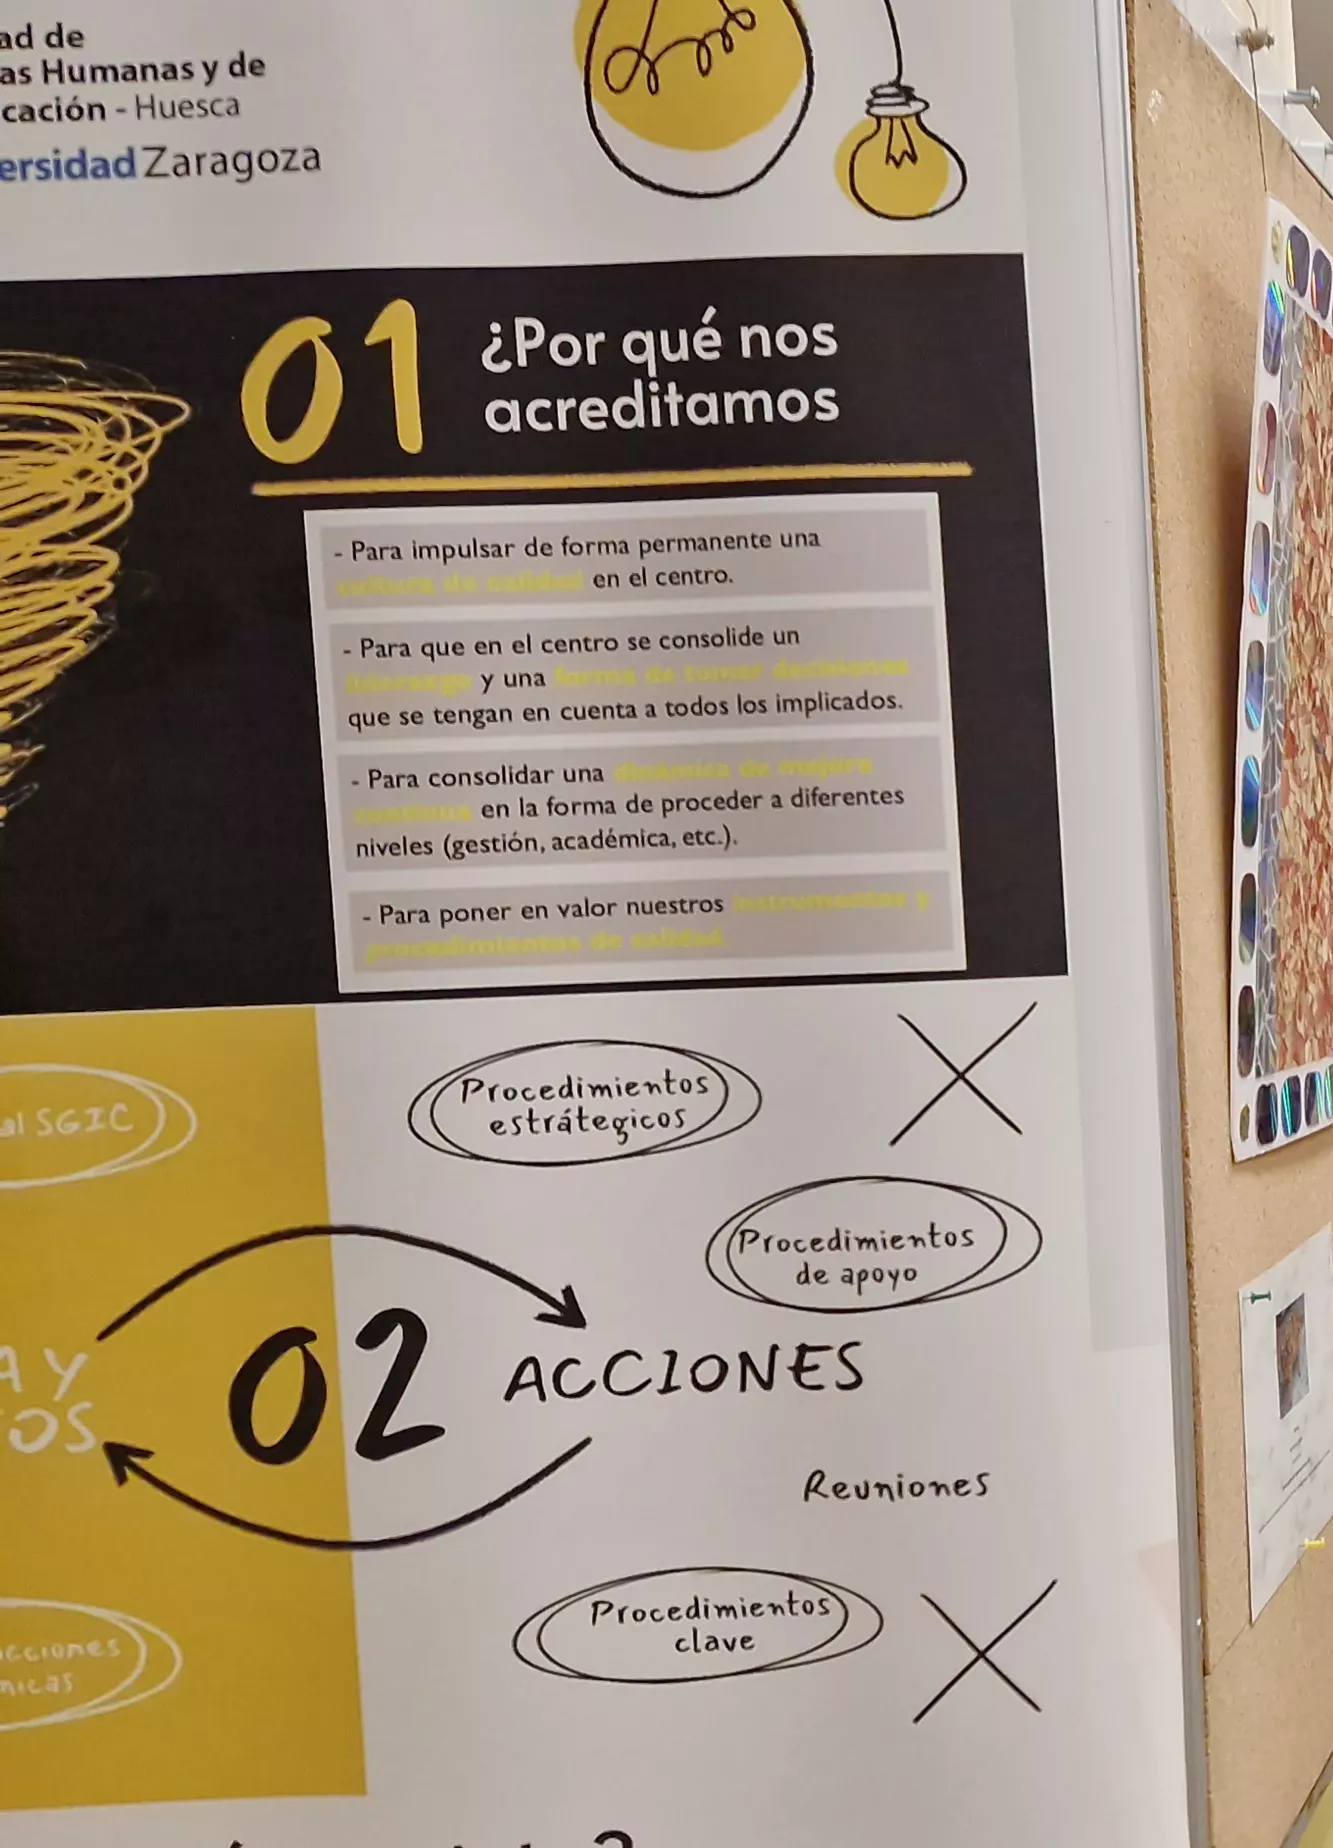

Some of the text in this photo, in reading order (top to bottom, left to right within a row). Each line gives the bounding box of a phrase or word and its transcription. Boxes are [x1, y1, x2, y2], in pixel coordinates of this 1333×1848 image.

[0, 22, 84, 49] ad de
[0, 51, 265, 86] as Humanas y de
[2, 96, 105, 122] cación
[136, 95, 239, 120] Huesca
[0, 146, 321, 183] ersidad Zaragoza
[482, 306, 837, 377] ¿Por qué nos
[241, 299, 423, 463] 01
[485, 379, 839, 432] acreditamos
[352, 541, 402, 561] Para
[413, 538, 514, 565] impulsar
[525, 537, 552, 556] de
[562, 536, 629, 556] forma
[639, 533, 771, 559] permanente
[781, 533, 820, 547] una
[593, 574, 619, 588] en
[629, 567, 646, 587] el
[656, 569, 732, 586] centro.
[361, 638, 411, 658] Para
[421, 642, 464, 662] que
[475, 641, 501, 654] en
[512, 634, 531, 654] el
[542, 637, 618, 653] centro
[628, 637, 650, 650] se
[660, 626, 763, 650] consolide
[774, 631, 799, 645] un
[481, 674, 493, 694] y
[504, 673, 546, 687] una
[349, 690, 902, 732] que se tengan en cuenta a todos los implicados.
[369, 769, 419, 788] Para
[429, 764, 553, 787] consolidar
[564, 768, 604, 782] una
[482, 804, 509, 818] en
[520, 797, 538, 817] la
[547, 796, 616, 816] forma
[626, 794, 652, 813] de
[662, 790, 762, 818] proceder
[771, 795, 783, 808] a
[791, 787, 904, 807] diferentes
[357, 824, 737, 860] niveles (gestión, académica, etc.).
[380, 905, 430, 924] Para
[440, 907, 511, 928] poner
[522, 906, 548, 919] en
[558, 898, 617, 917] valor
[627, 899, 723, 915] nuestros
[461, 1068, 709, 1104] Procedimientos
[37, 1102, 132, 1136] SGIC
[489, 1105, 687, 1146] estrátegicos
[735, 1219, 973, 1253] Procedimientos
[797, 1262, 917, 1296] de apoyo
[44, 1349, 88, 1400] Y
[228, 1307, 446, 1466] 02
[504, 1342, 863, 1402] ACCIONES
[804, 1470, 989, 1502] Reuniones
[590, 1591, 834, 1626] Procedimientos
[0, 1638, 121, 1662] cciones
[675, 1627, 754, 1653] clave
